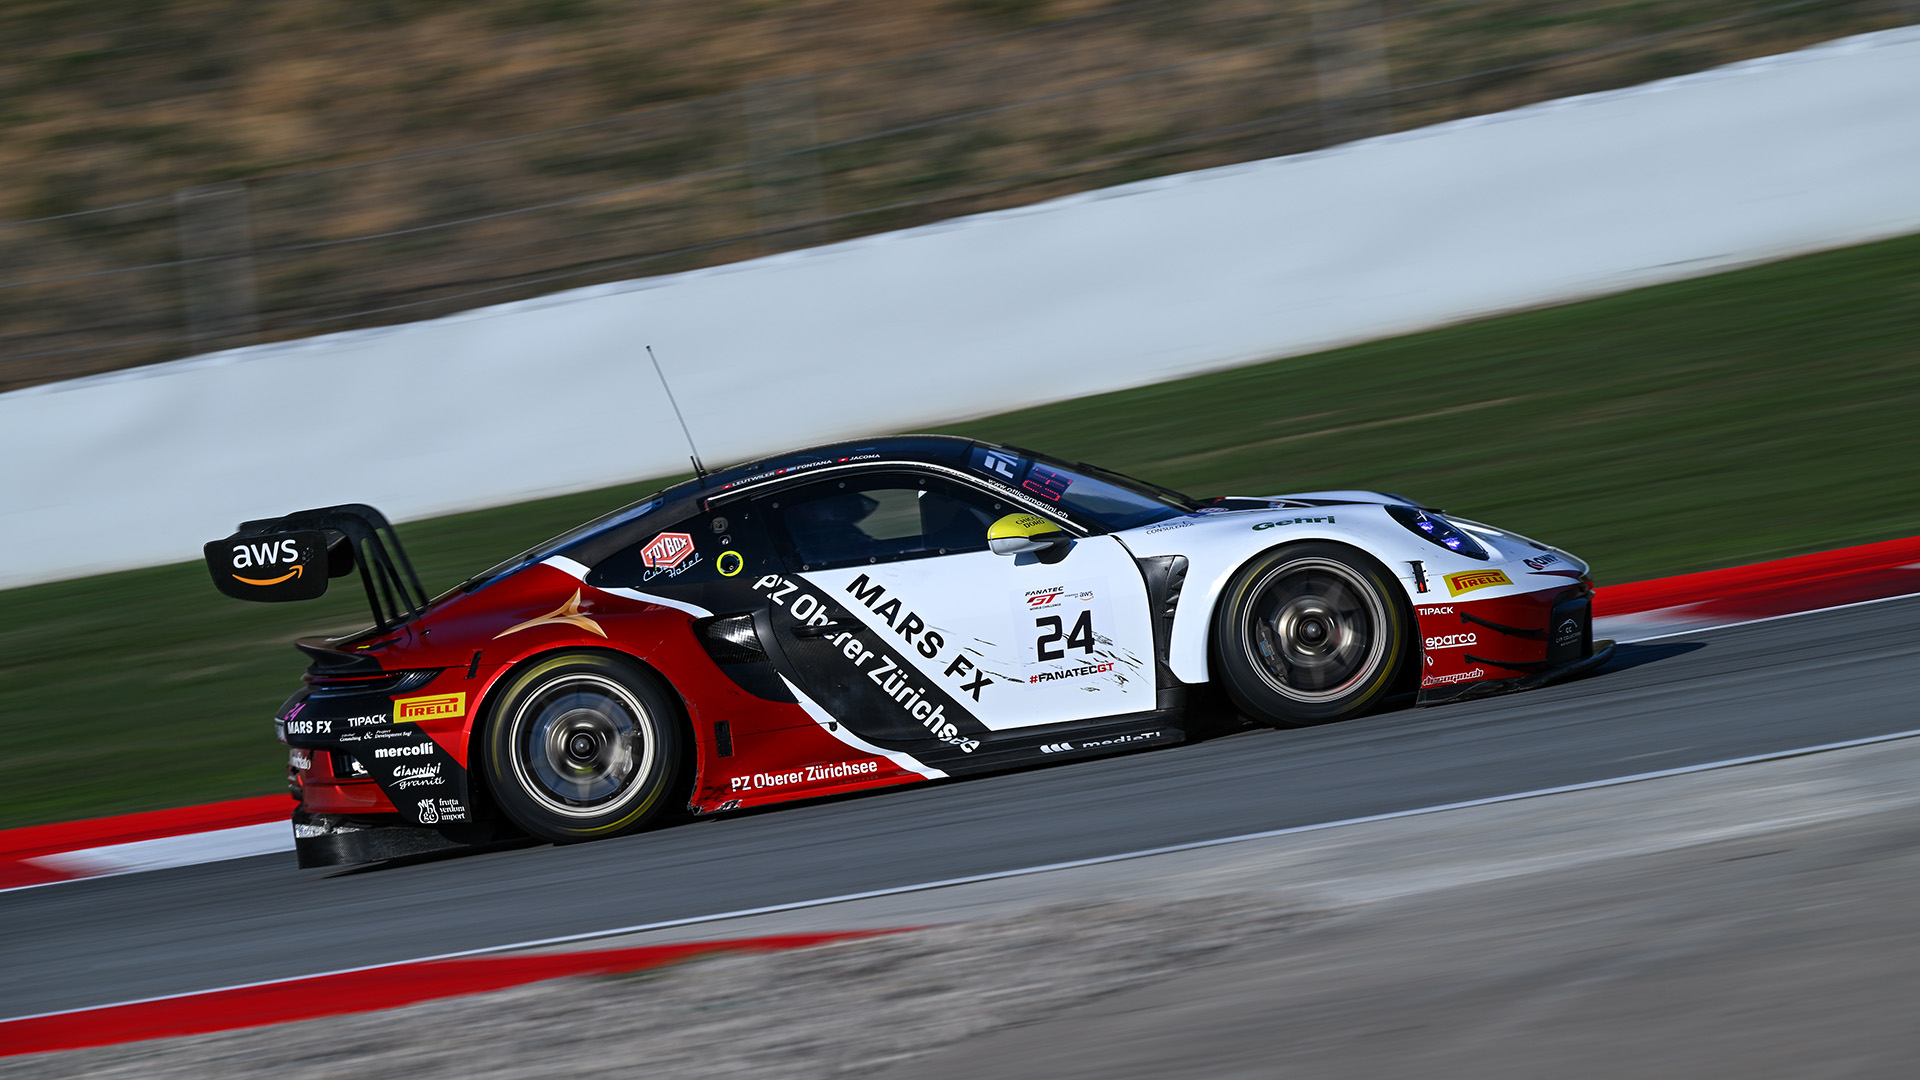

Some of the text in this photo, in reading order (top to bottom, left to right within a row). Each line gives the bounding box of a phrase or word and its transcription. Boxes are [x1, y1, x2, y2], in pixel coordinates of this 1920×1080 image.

[732, 453, 881, 487] LEUTWILER FONTANA JACOMA
[233, 539, 299, 569] aws
[645, 537, 688, 558] TOYBOX
[1451, 571, 1506, 591] PIRELLI
[1024, 585, 1064, 597] FANATEC
[1026, 591, 1065, 607] GT
[1079, 590, 1094, 598] aws
[1418, 606, 1454, 616] TIPACK
[845, 573, 995, 703] MARS FX
[1035, 609, 1096, 663] 24
[1425, 632, 1477, 650] sparco
[752, 573, 799, 606] PZ
[867, 654, 981, 754] Zürichsee
[1029, 662, 1115, 685] #FANATECGT
[283, 702, 307, 721] 24
[400, 697, 459, 718] PIRELLI
[287, 720, 333, 735] MARS FX
[347, 713, 387, 728] TIPACK
[375, 742, 434, 759] mercolli
[731, 776, 752, 792] PZ
[753, 771, 804, 790] Oberer
[805, 760, 878, 783] Zürichsee
[441, 812, 466, 822] import
